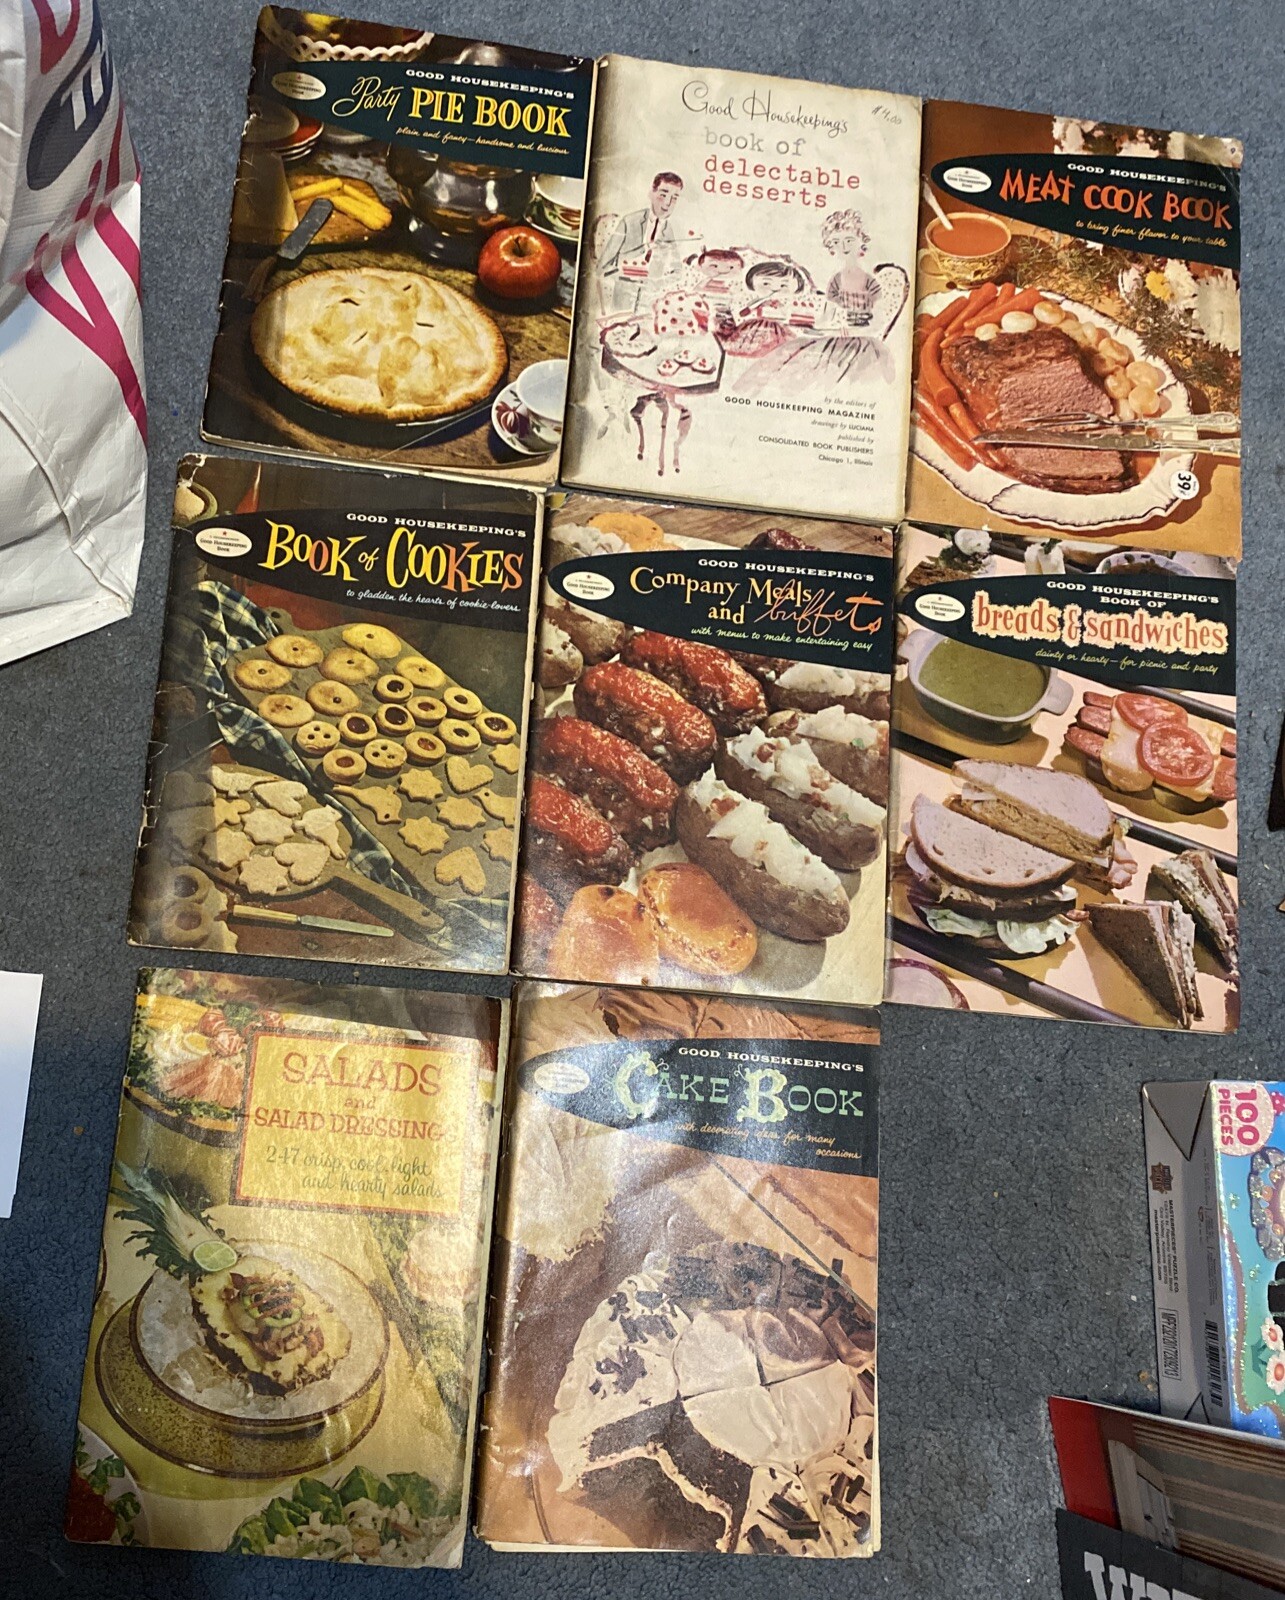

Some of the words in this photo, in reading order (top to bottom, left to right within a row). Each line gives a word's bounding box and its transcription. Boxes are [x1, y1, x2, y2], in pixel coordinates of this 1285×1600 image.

[406, 68, 445, 80] GOOD
[451, 75, 575, 100] HOUSEKEEPING'S
[332, 76, 405, 121] Party
[408, 87, 466, 124] PIE
[473, 96, 572, 138] BOOK
[682, 80, 738, 120] Good
[742, 90, 848, 138] Housekeeping's
[396, 127, 420, 137] plain
[423, 131, 440, 139] and
[518, 143, 534, 151] and
[704, 127, 764, 153] book
[776, 138, 807, 156] of
[704, 154, 860, 189] delectable
[1067, 162, 1104, 175] GOOD
[1110, 168, 1227, 192] HOUSEKEEPING'S
[703, 175, 828, 208] desserts
[999, 168, 1076, 204] MEAT
[1084, 184, 1153, 220] COOK
[1162, 190, 1233, 230] BOOK
[1076, 220, 1084, 228] to
[1087, 220, 1110, 235] bring
[1138, 227, 1168, 240] flavor
[1170, 232, 1180, 240] to
[1182, 235, 1203, 246] your
[1205, 236, 1228, 248] table
[724, 396, 751, 406] GOOD
[756, 400, 823, 414] HOUSEKEEPING
[828, 408, 876, 420] MAGAZINE
[840, 422, 848, 430] by
[848, 424, 874, 432] LUCIANA
[867, 437, 874, 445] by
[758, 435, 810, 448] CONSOLIDATED
[812, 442, 833, 450] BOOK
[836, 445, 874, 455] PUBLISHERS
[818, 454, 844, 464] Chicago
[854, 458, 874, 466] Illinois
[346, 512, 388, 524] GOOD
[394, 517, 527, 538] HOUSEKEEPING'S
[258, 518, 367, 582] BOOK
[358, 546, 380, 572] of
[386, 526, 524, 594] COOKIES
[698, 558, 739, 569] GOOD
[745, 562, 875, 582] HOUSEKEEPING'S
[630, 566, 740, 605] Company
[747, 577, 812, 606] Meals
[1046, 581, 1086, 592] GOOD
[1092, 585, 1220, 604] HOUSEKEEPING'S
[346, 589, 356, 597] to
[357, 590, 397, 603] gladden
[398, 592, 414, 603] the
[416, 594, 444, 606] hearts
[446, 597, 456, 610] of
[459, 598, 522, 613] cookie-lovers
[708, 604, 745, 625] and
[1100, 596, 1140, 608] BOOK
[1147, 600, 1166, 609] OF
[976, 594, 1058, 634] breads
[1086, 610, 1224, 650] sandwiches
[691, 626, 713, 636] with
[718, 629, 748, 639] menus
[751, 630, 761, 640] to
[764, 632, 792, 644] make
[795, 636, 850, 652] entertaining
[852, 640, 874, 652] easy
[1036, 648, 1064, 662] dainty
[1139, 659, 1168, 670] picnic
[1172, 662, 1190, 671] and
[1194, 664, 1219, 676] party
[678, 1047, 720, 1058] GOOD
[728, 1052, 864, 1072] HOUSEKEEPING'S
[283, 1052, 442, 1096] SALADS
[606, 1050, 730, 1119] CAKE
[734, 1064, 864, 1123] BOOK
[344, 1096, 376, 1110] and
[1218, 1088, 1234, 1146] PIECES
[1235, 1088, 1260, 1146] 100
[254, 1106, 325, 1132] SALAD
[700, 1123, 750, 1141] decorating
[782, 1130, 803, 1146] for
[806, 1134, 836, 1147] many
[266, 1145, 300, 1164] 247
[392, 1155, 432, 1182] light
[816, 1148, 862, 1160] occasions
[302, 1172, 334, 1190] and
[340, 1171, 387, 1199] hearty
